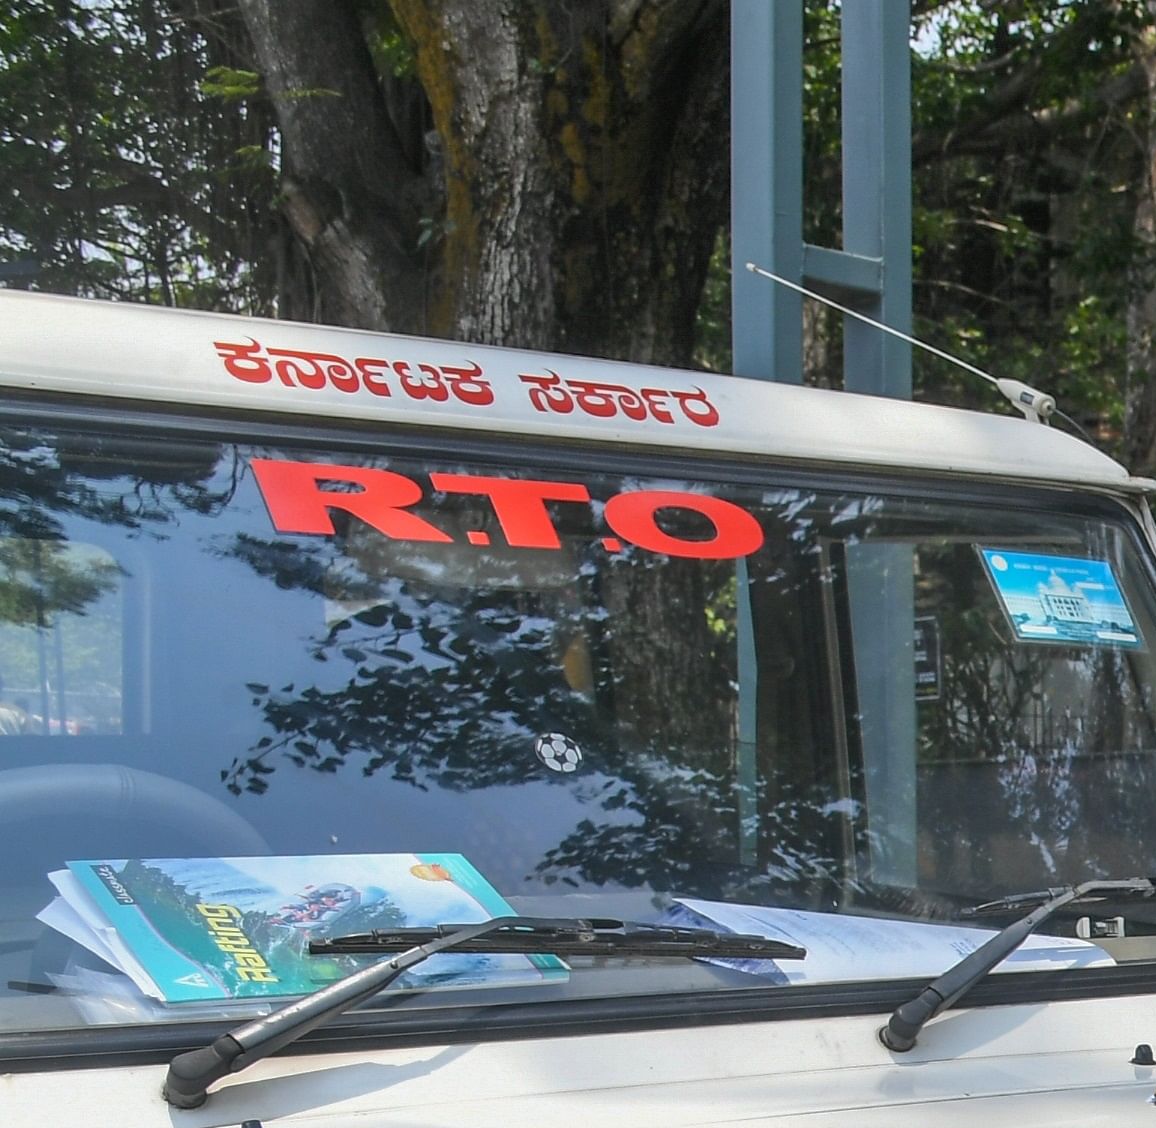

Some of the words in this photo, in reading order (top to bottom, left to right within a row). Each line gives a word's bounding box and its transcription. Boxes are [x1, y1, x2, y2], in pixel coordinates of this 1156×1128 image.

[213, 336, 494, 406] ಕರ್ನಾಟಕ
[517, 368, 720, 427] ಸರ್ಕಾರ
[250, 457, 764, 560] R.T.O
[195, 903, 279, 983] Rafting
